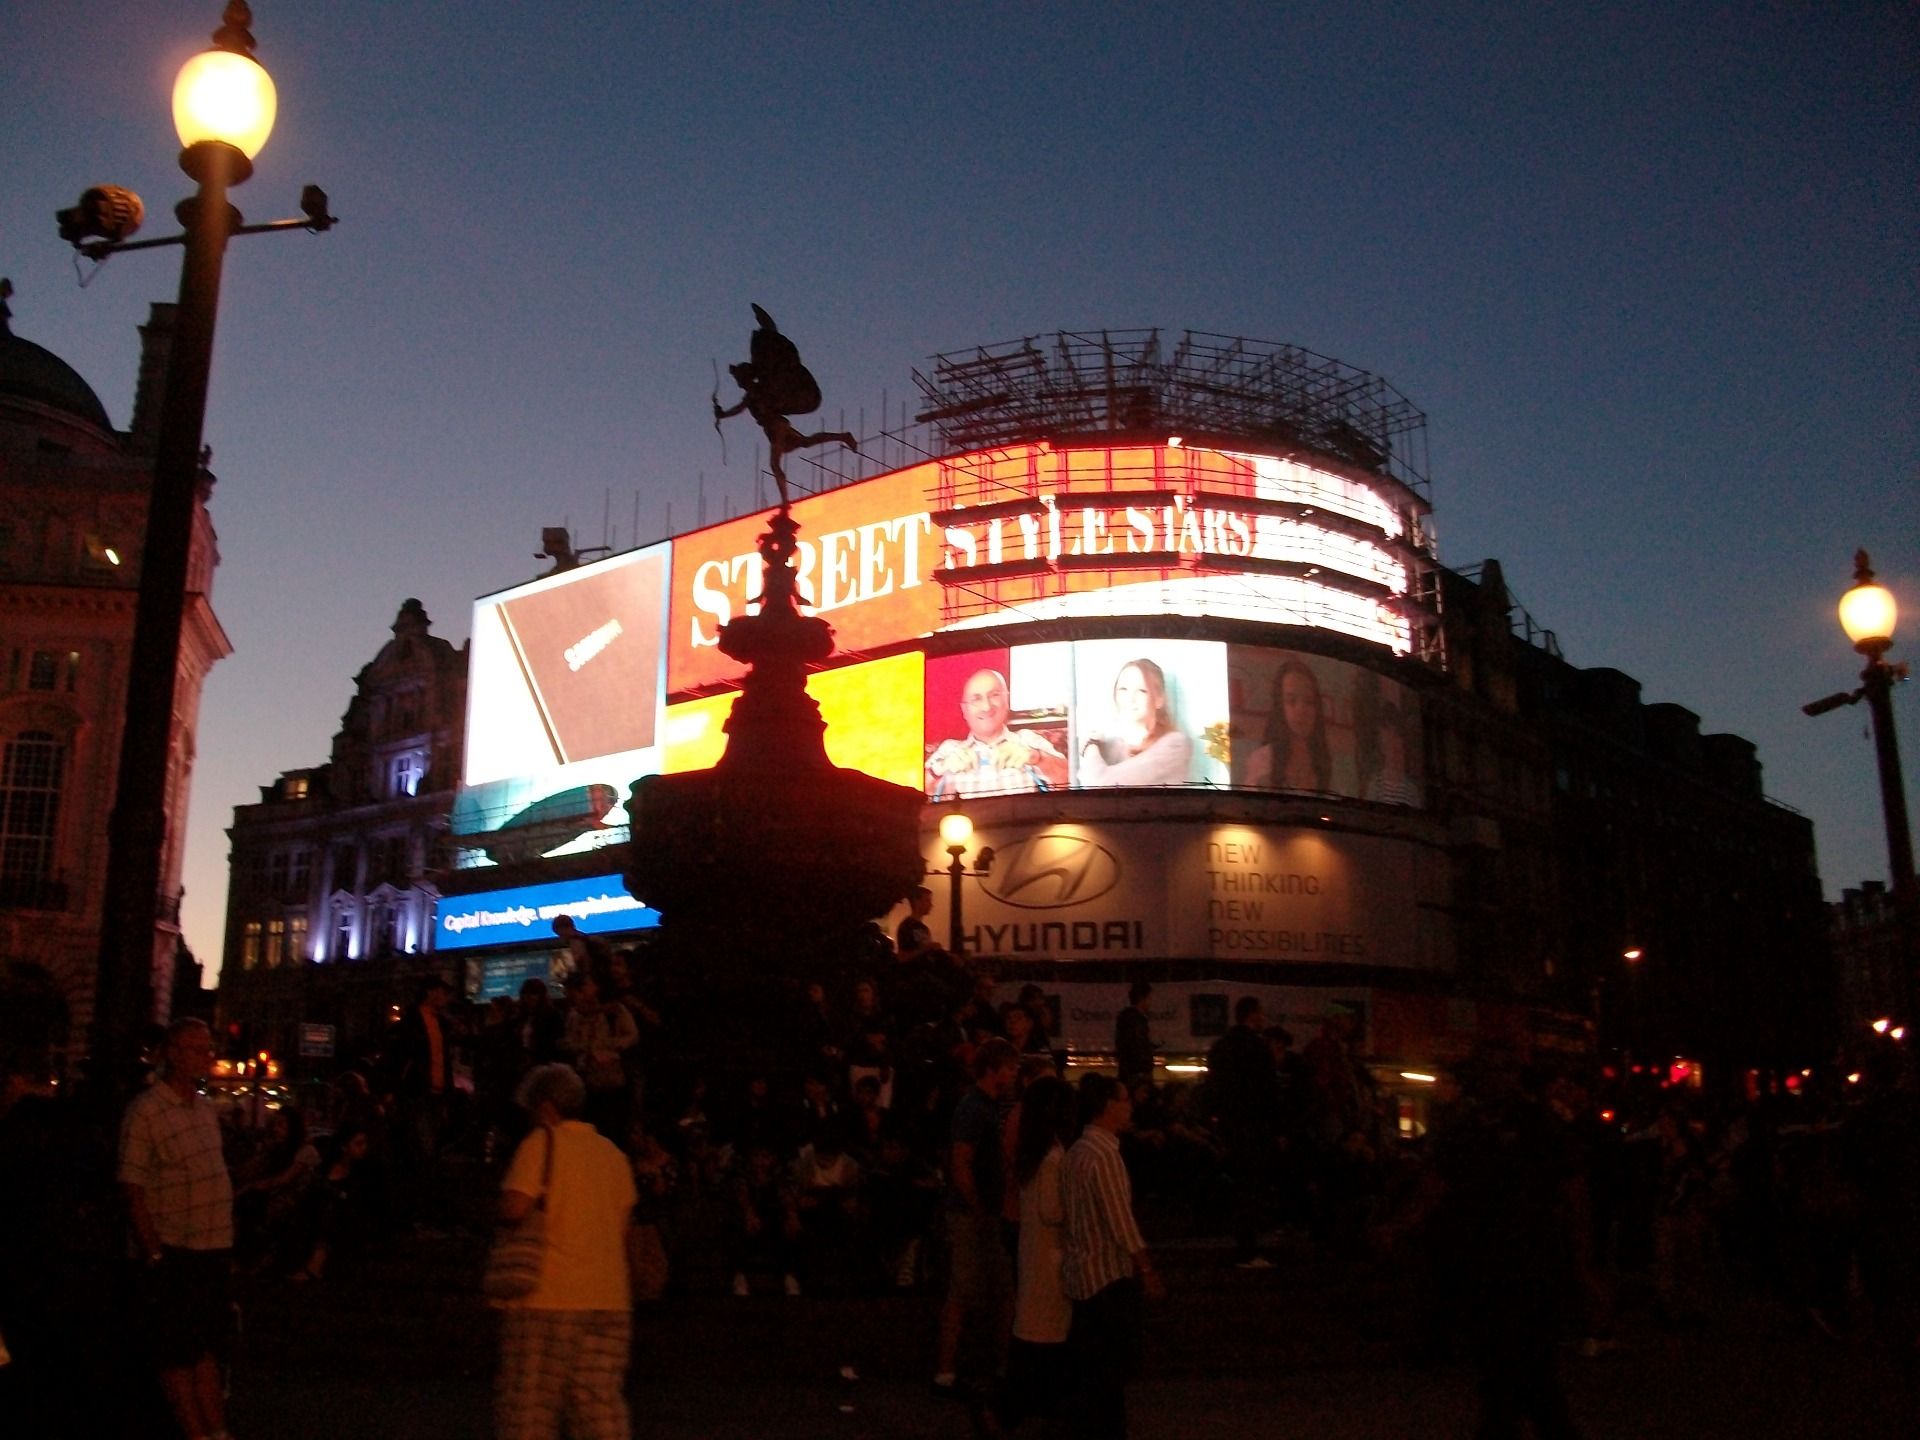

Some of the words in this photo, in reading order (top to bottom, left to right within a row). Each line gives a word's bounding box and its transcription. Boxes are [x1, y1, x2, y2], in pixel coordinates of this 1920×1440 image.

[944, 494, 1114, 569] STYLE
[1126, 494, 1253, 557] STARS
[1207, 843, 1262, 864] NEW
[1208, 899, 1264, 921] NEW
[957, 920, 1143, 952] HYUNDAI
